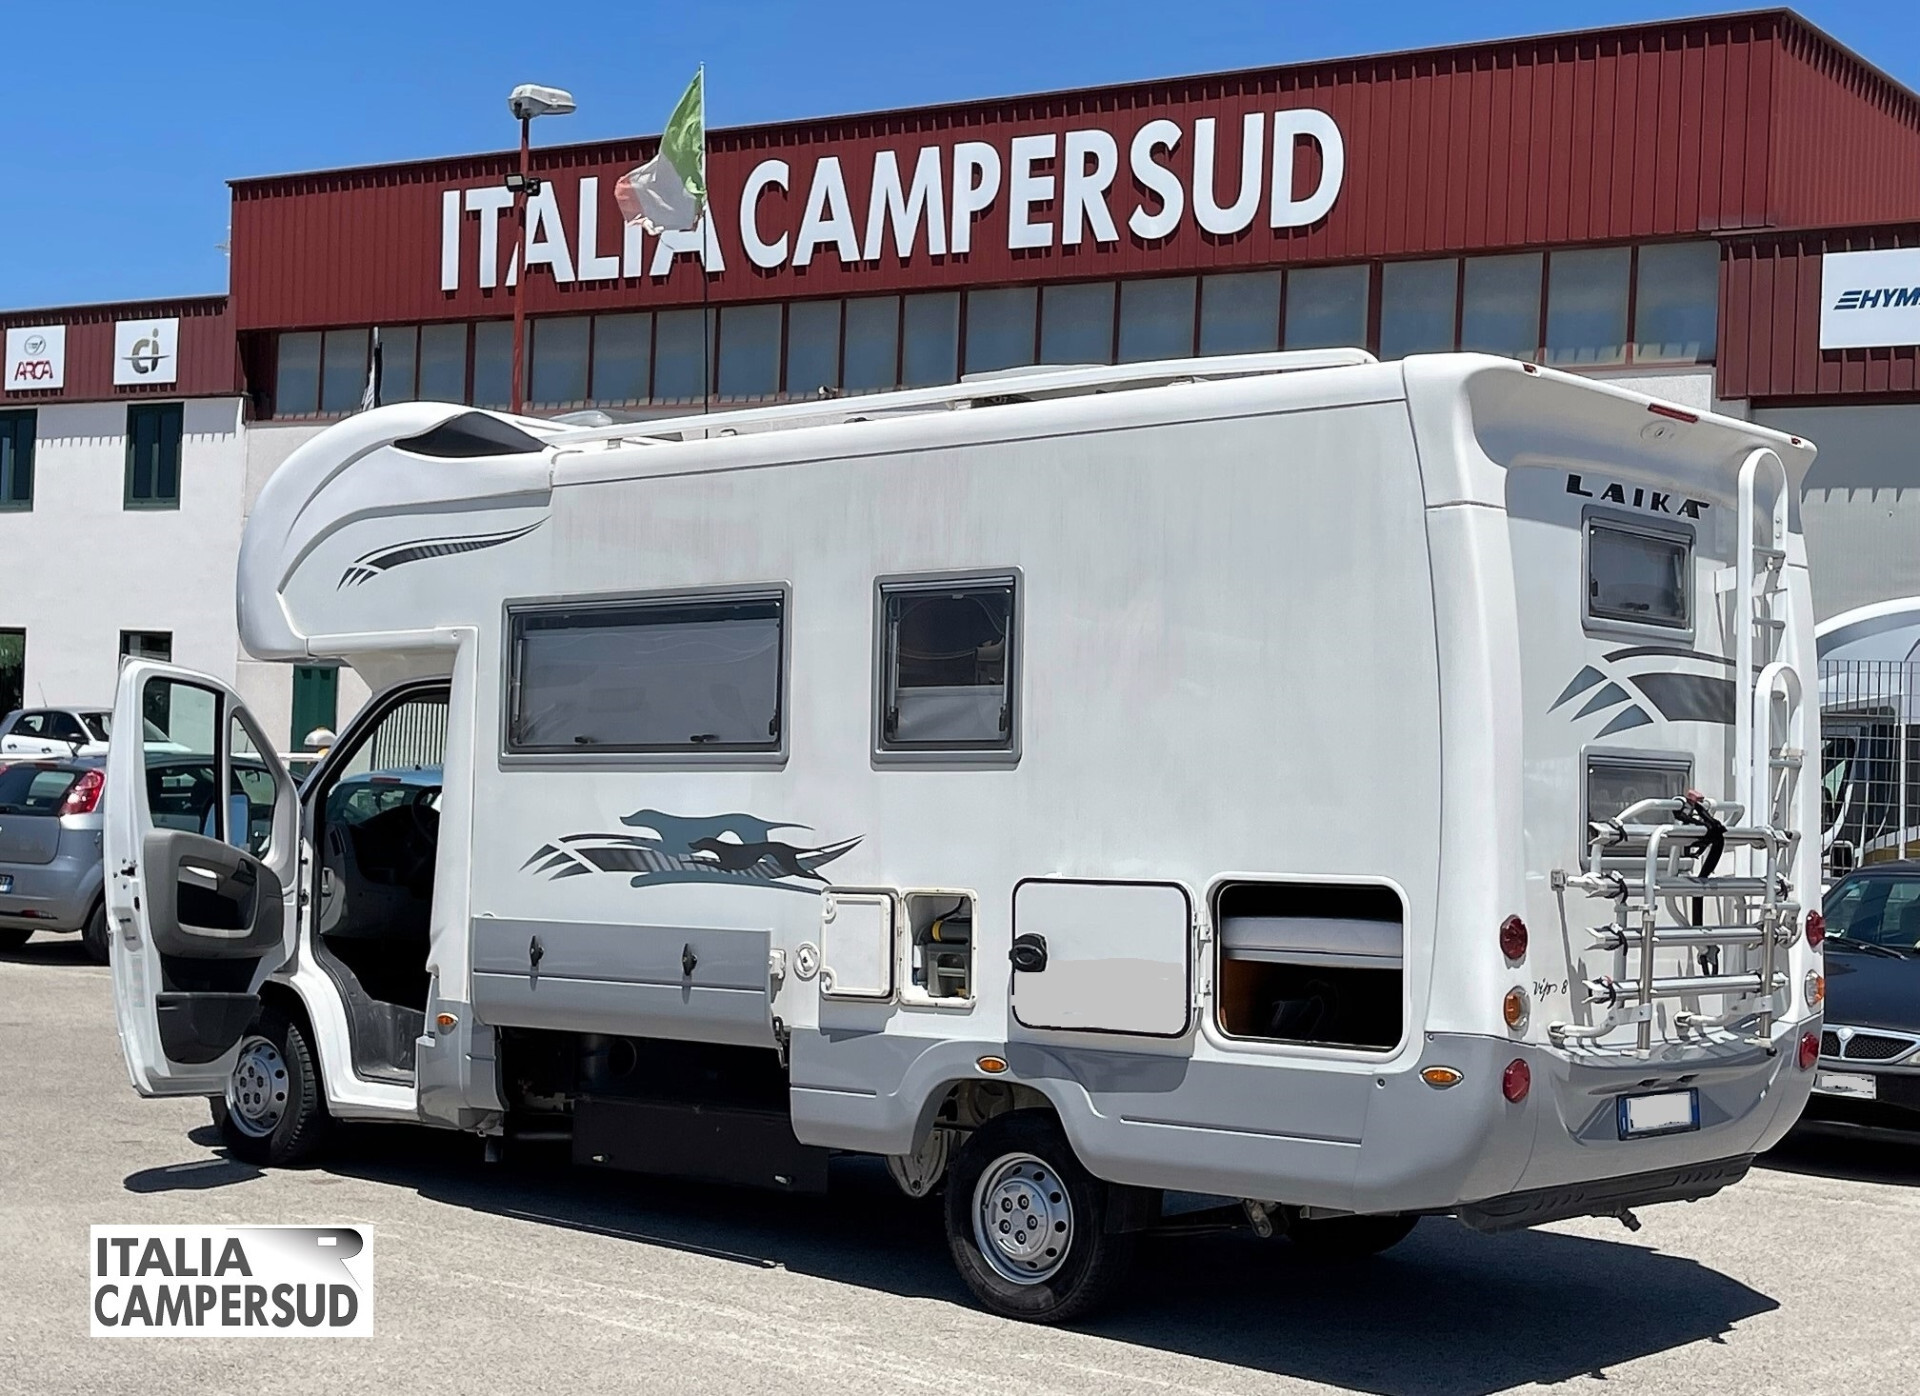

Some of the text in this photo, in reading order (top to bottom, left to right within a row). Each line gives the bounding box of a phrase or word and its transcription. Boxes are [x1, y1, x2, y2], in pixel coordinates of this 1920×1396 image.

[440, 108, 1345, 291] ITALIA CAMPERSUD
[1858, 286, 1920, 310] HYM
[14, 360, 53, 381] ARCA
[1566, 474, 1709, 519] LAIKA
[1561, 979, 1569, 995] 8
